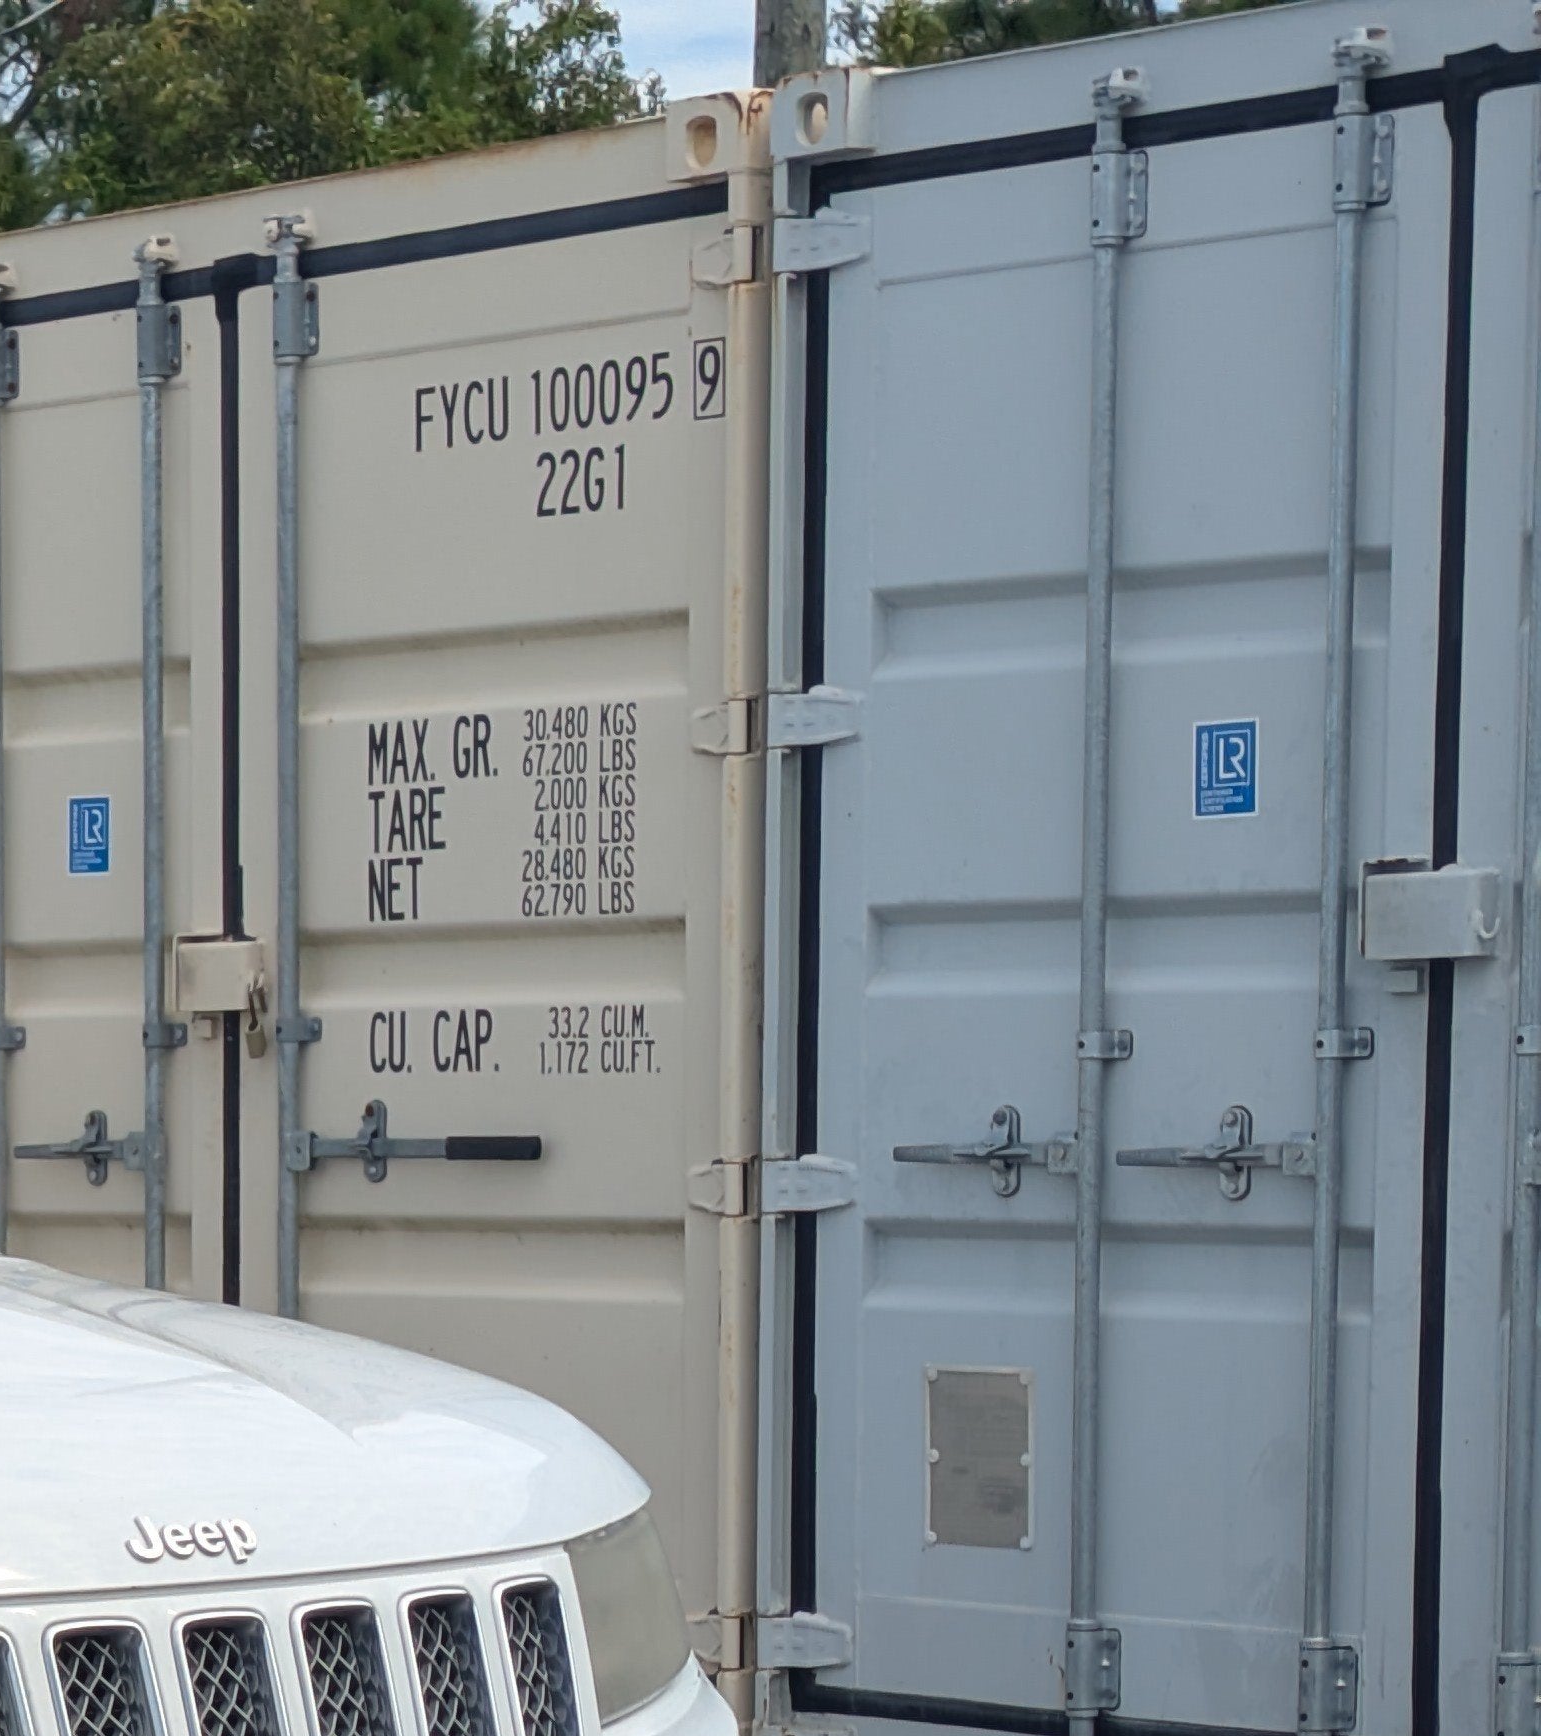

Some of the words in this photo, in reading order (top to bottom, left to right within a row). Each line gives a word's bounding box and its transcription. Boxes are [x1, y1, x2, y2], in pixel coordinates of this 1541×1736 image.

[415, 375, 509, 453] FYCU
[530, 351, 674, 436] 100095
[698, 345, 721, 412] 9
[536, 443, 626, 518] 22G1
[522, 705, 589, 742] 30.480
[599, 702, 638, 737] KGS
[367, 718, 436, 786] MAX.
[453, 713, 499, 779] GR.
[522, 741, 588, 778] 67.200
[598, 738, 637, 773] LBS
[1218, 737, 1246, 780] LR
[534, 776, 588, 812] 2.000
[598, 773, 637, 809] KGS
[83, 808, 103, 844] LR
[367, 786, 447, 854] TARE
[533, 812, 587, 847] 4.410
[598, 809, 636, 844] LBS
[521, 848, 588, 883] 28.480
[598, 845, 636, 880] KGS
[367, 856, 424, 922] NET
[598, 881, 635, 915] LBS
[369, 1010, 413, 1074] CU.
[432, 1008, 501, 1073] CAP.
[547, 1006, 589, 1039] 33.2
[539, 1041, 589, 1075] 1.172
[125, 1515, 257, 1565] Jeep
